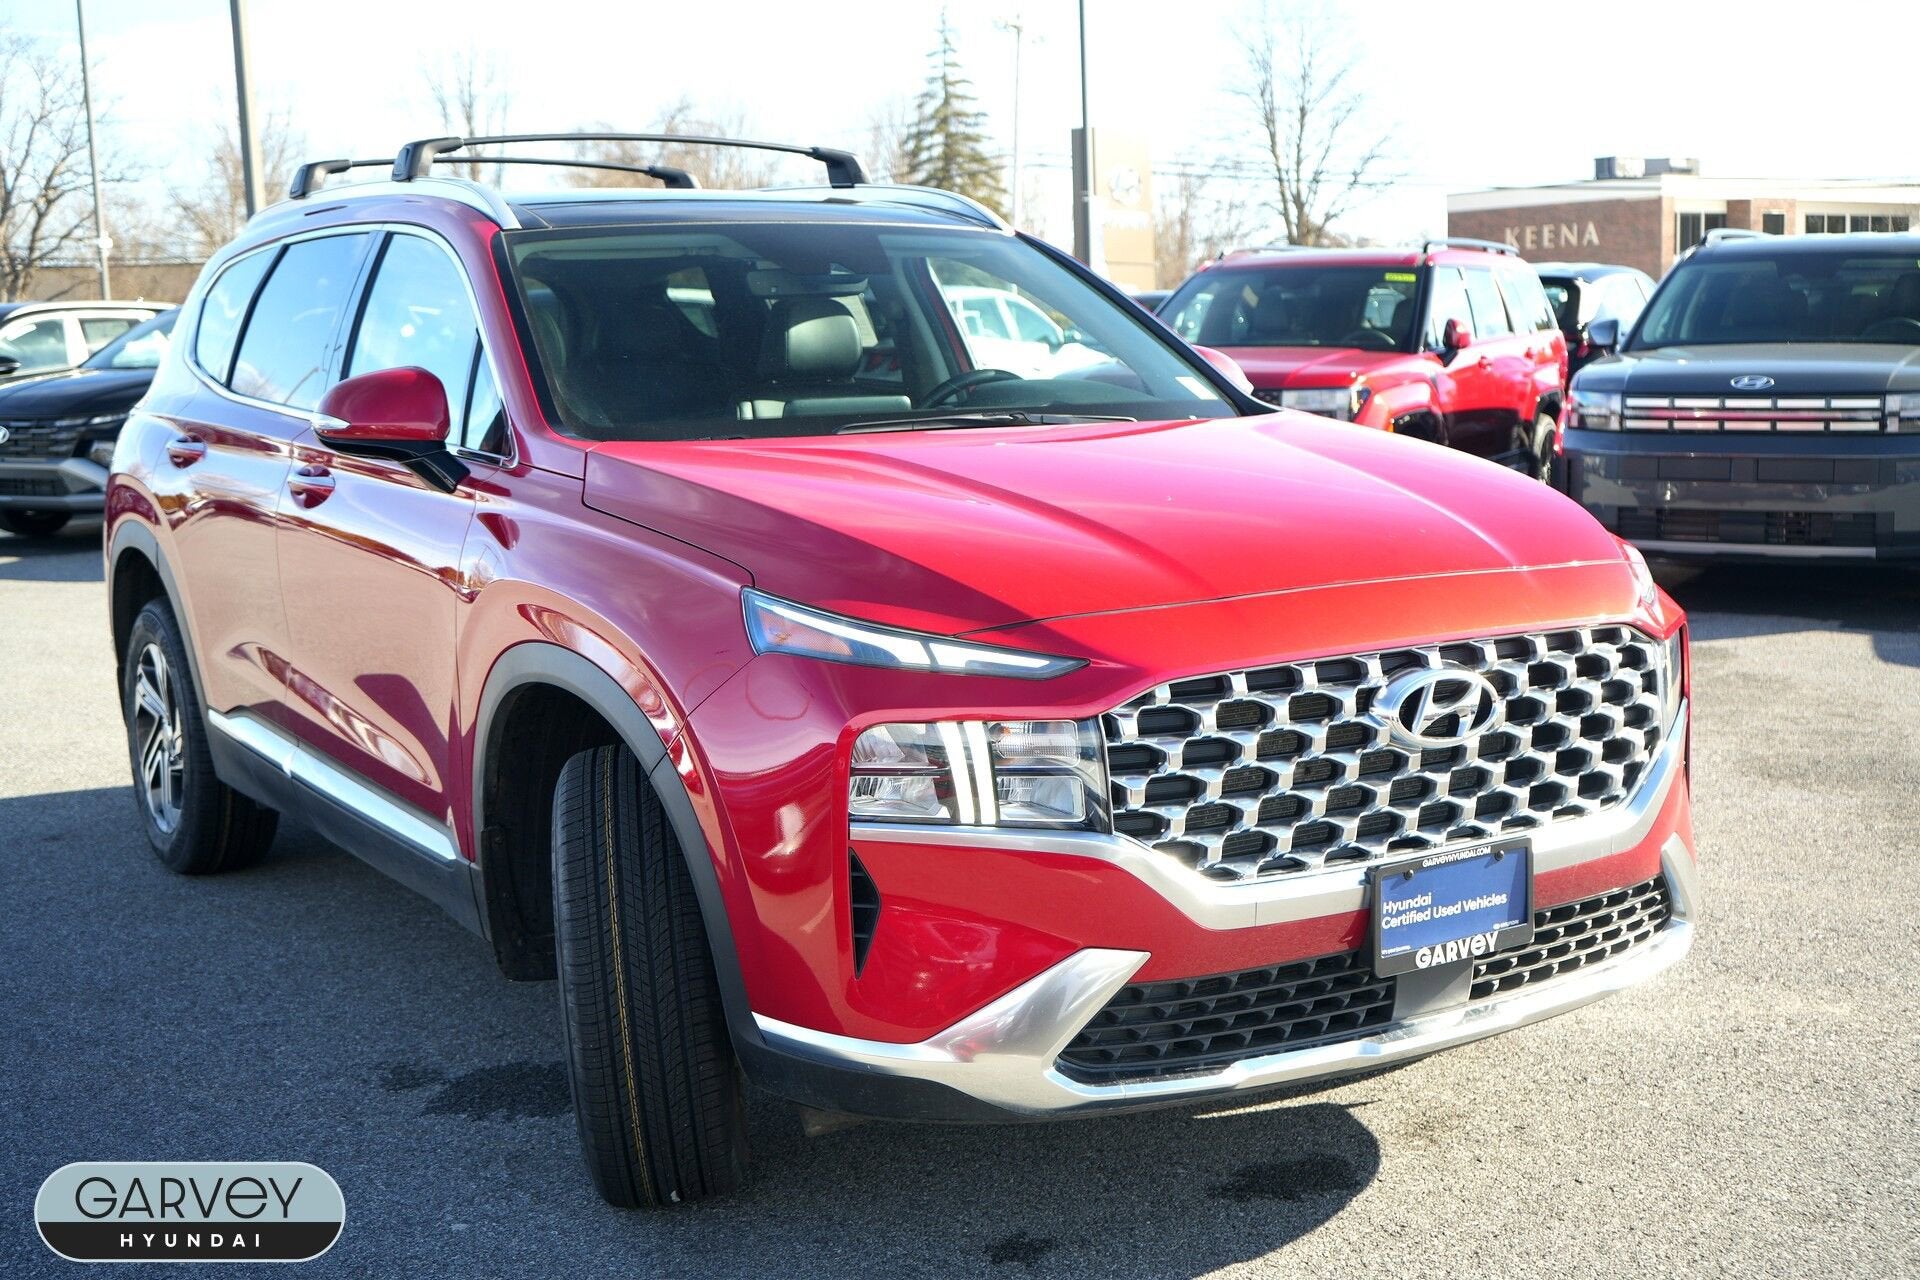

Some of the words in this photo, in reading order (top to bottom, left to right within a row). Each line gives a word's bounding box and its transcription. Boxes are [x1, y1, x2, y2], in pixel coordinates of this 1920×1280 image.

[1504, 221, 1600, 250] KEENA
[1381, 908, 1431, 930] Certified
[1433, 902, 1462, 918] Used
[1462, 893, 1508, 912] Vehicles
[1383, 892, 1432, 915] Hyundai
